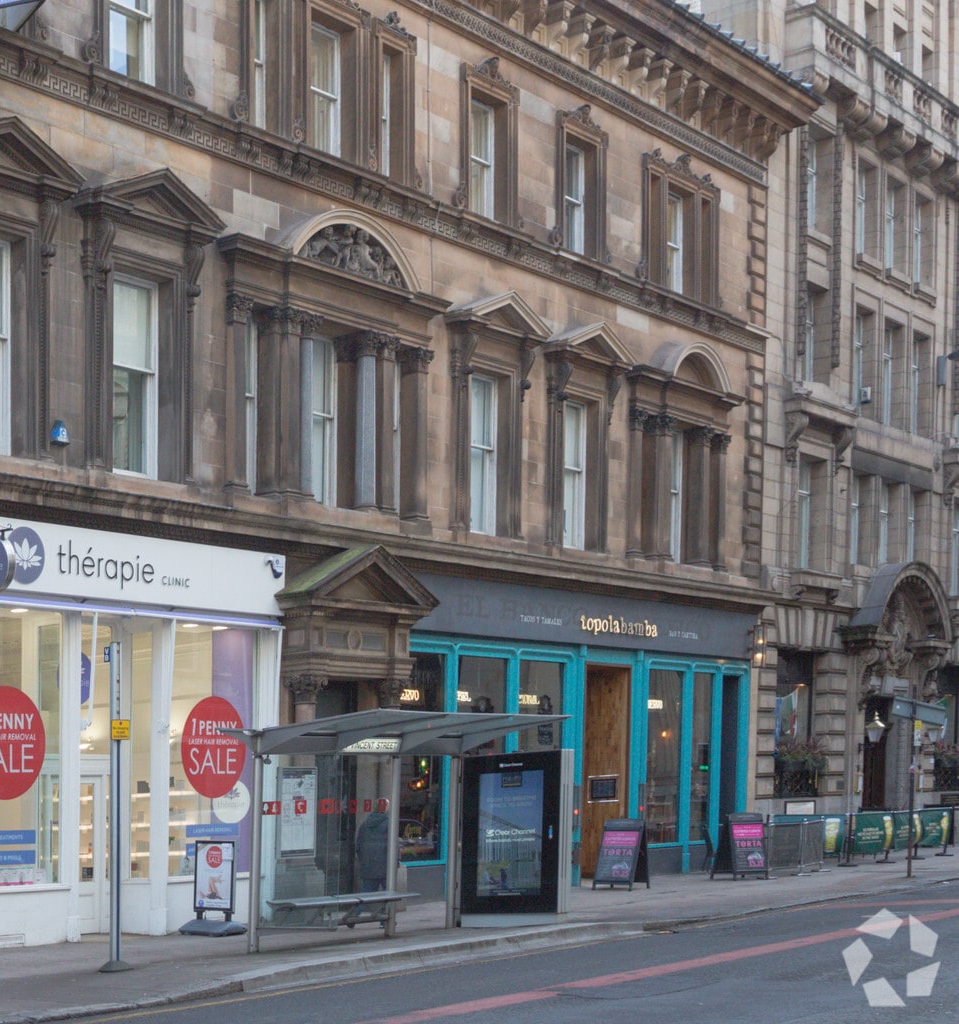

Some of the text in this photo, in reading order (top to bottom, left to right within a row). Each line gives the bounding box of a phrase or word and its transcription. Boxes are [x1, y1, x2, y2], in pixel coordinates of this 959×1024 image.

[57, 539, 191, 590] thérapie CLINIC
[580, 614, 658, 638] topolabamba
[191, 718, 197, 736] 1
[8, 732, 37, 741] REMOVAL
[188, 738, 239, 746] LASER HAIR REMOVAL
[376, 741, 398, 750] STREET
[189, 747, 237, 775] SALE
[511, 827, 536, 836] Channel
